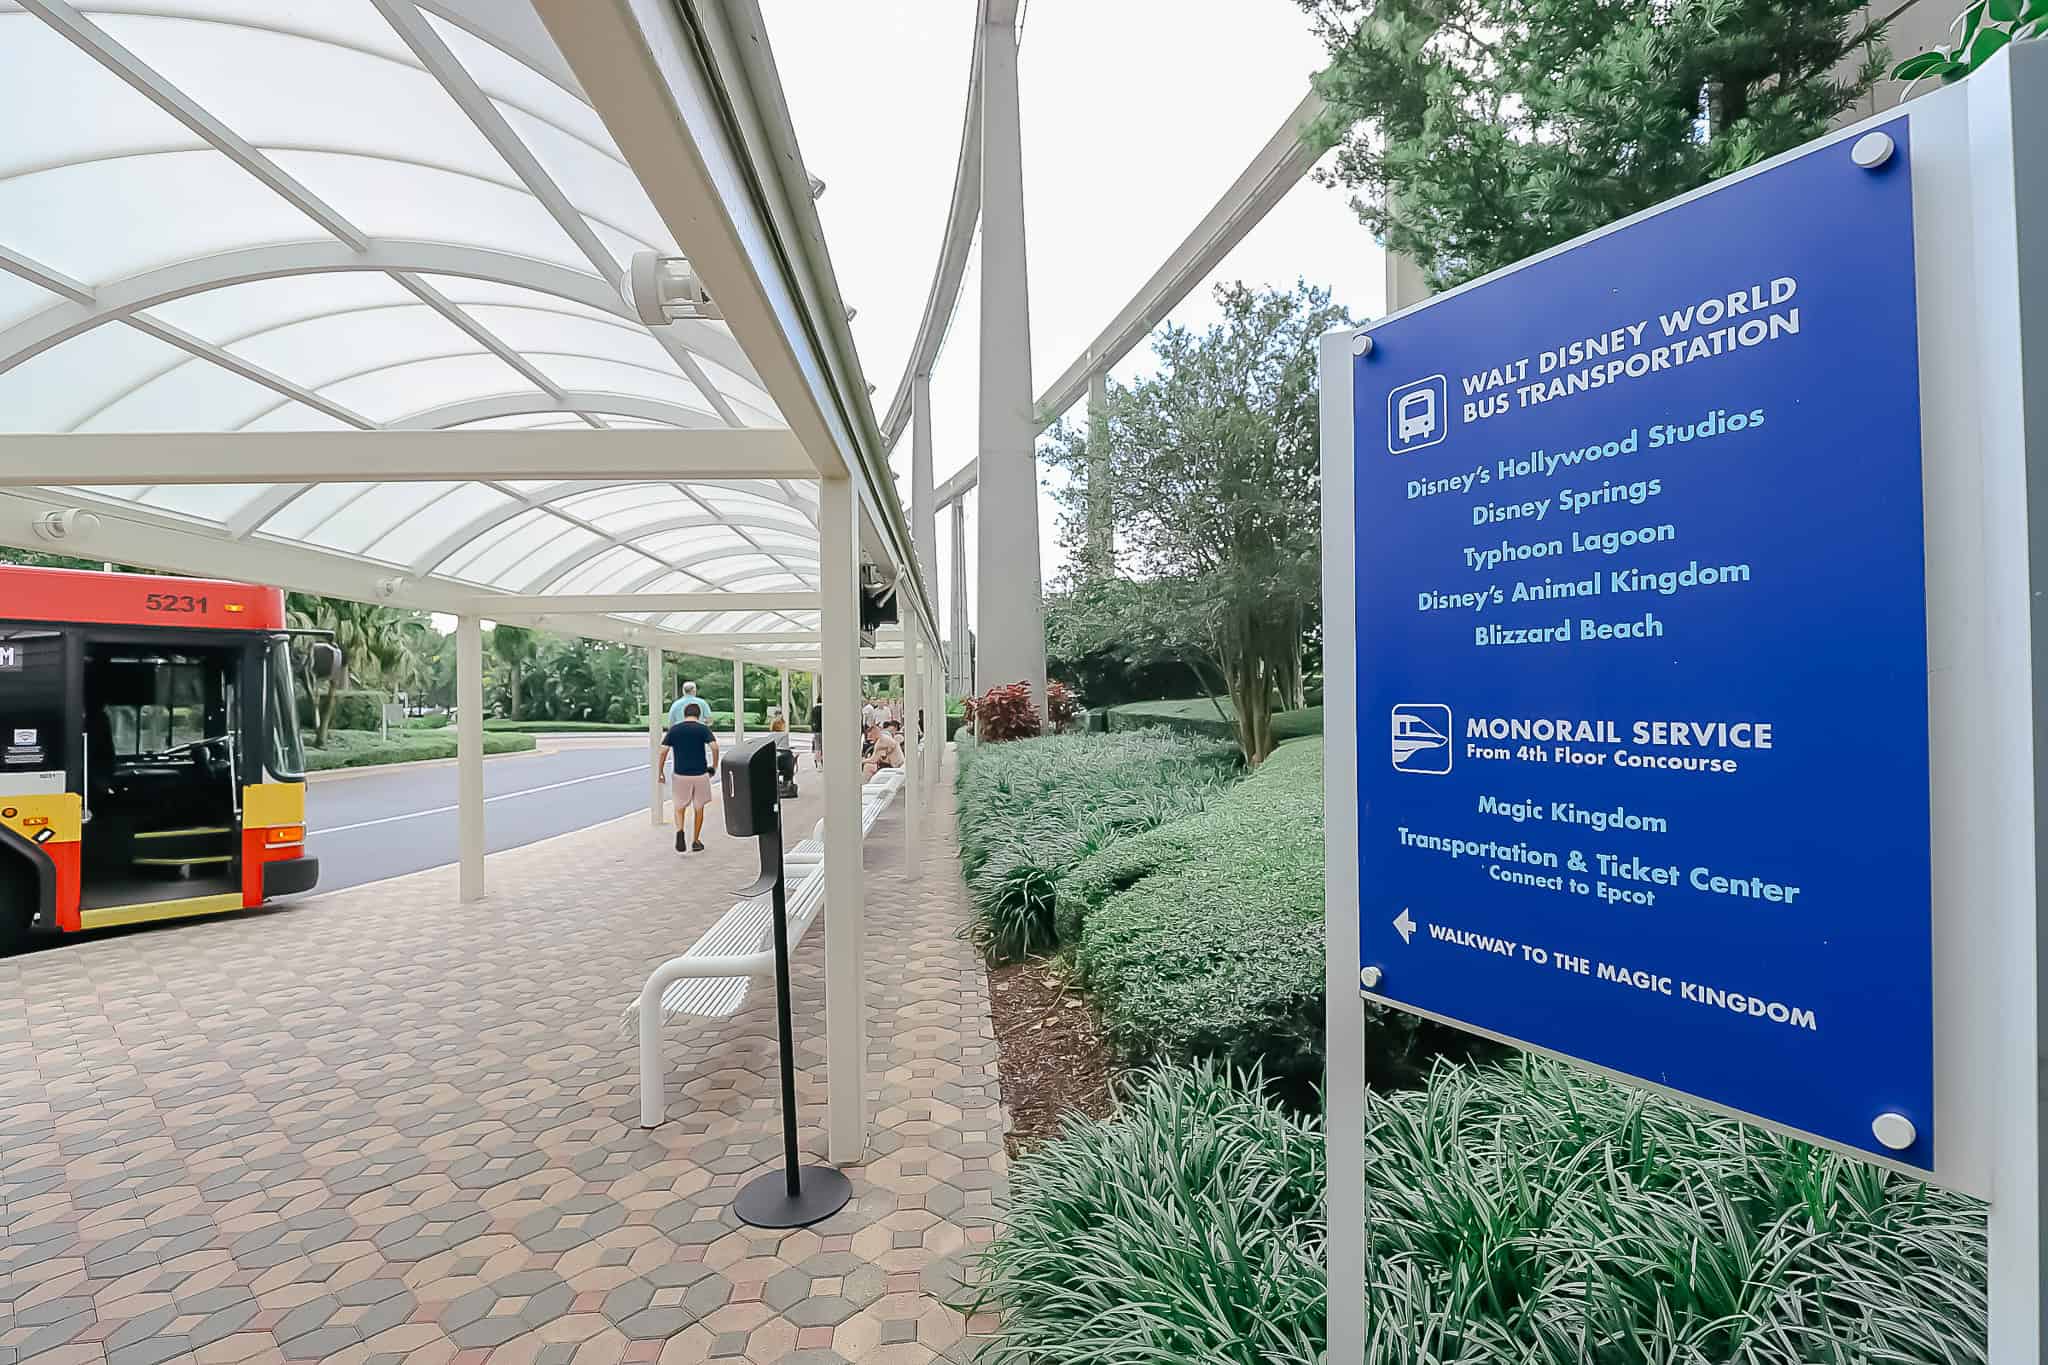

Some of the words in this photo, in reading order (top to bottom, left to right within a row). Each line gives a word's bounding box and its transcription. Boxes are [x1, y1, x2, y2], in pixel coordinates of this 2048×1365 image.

[1462, 358, 1529, 396] WALT
[1539, 320, 1648, 374] DISNEY
[1658, 275, 1800, 338] WORLD
[1463, 392, 1510, 423] BUS
[1516, 307, 1801, 408] TRANSPORTATION
[1407, 465, 1491, 500] Disney's
[1498, 428, 1638, 481] Hollywood
[1648, 408, 1765, 448] Studios
[1473, 498, 1552, 526] Disney
[1559, 478, 1662, 515] Springs
[1463, 540, 1563, 572] Typhoon
[1572, 524, 1675, 555] Lagoon
[145, 594, 208, 614] 5231
[1418, 584, 1504, 612] Disney's
[1511, 571, 1601, 603] Animal
[1611, 560, 1750, 595] Kingdom
[1475, 618, 1571, 646] Blizzard
[1580, 612, 1664, 641] Beach
[1466, 717, 1622, 744] MONORAIL
[1632, 720, 1773, 749] SERVICE
[1466, 743, 1511, 761] From
[1516, 744, 1548, 762] 4th
[1554, 745, 1607, 766] Floor
[1613, 749, 1738, 773] Concourse
[1478, 795, 1544, 823] Magic
[1551, 801, 1667, 833] Kingdom
[1397, 826, 1558, 869] Transportation
[1566, 849, 1589, 873] &
[1595, 853, 1681, 887] Ticket
[1689, 866, 1801, 904] Center
[1488, 864, 1564, 891] Connect
[1568, 878, 1590, 895] to
[1596, 880, 1656, 907] Epcot
[1428, 923, 1517, 957] WALKWAY
[1521, 944, 1548, 965] TO
[1552, 951, 1591, 976] THE
[1596, 962, 1672, 996] MAGIC
[1680, 981, 1817, 1031] KINGDOM
